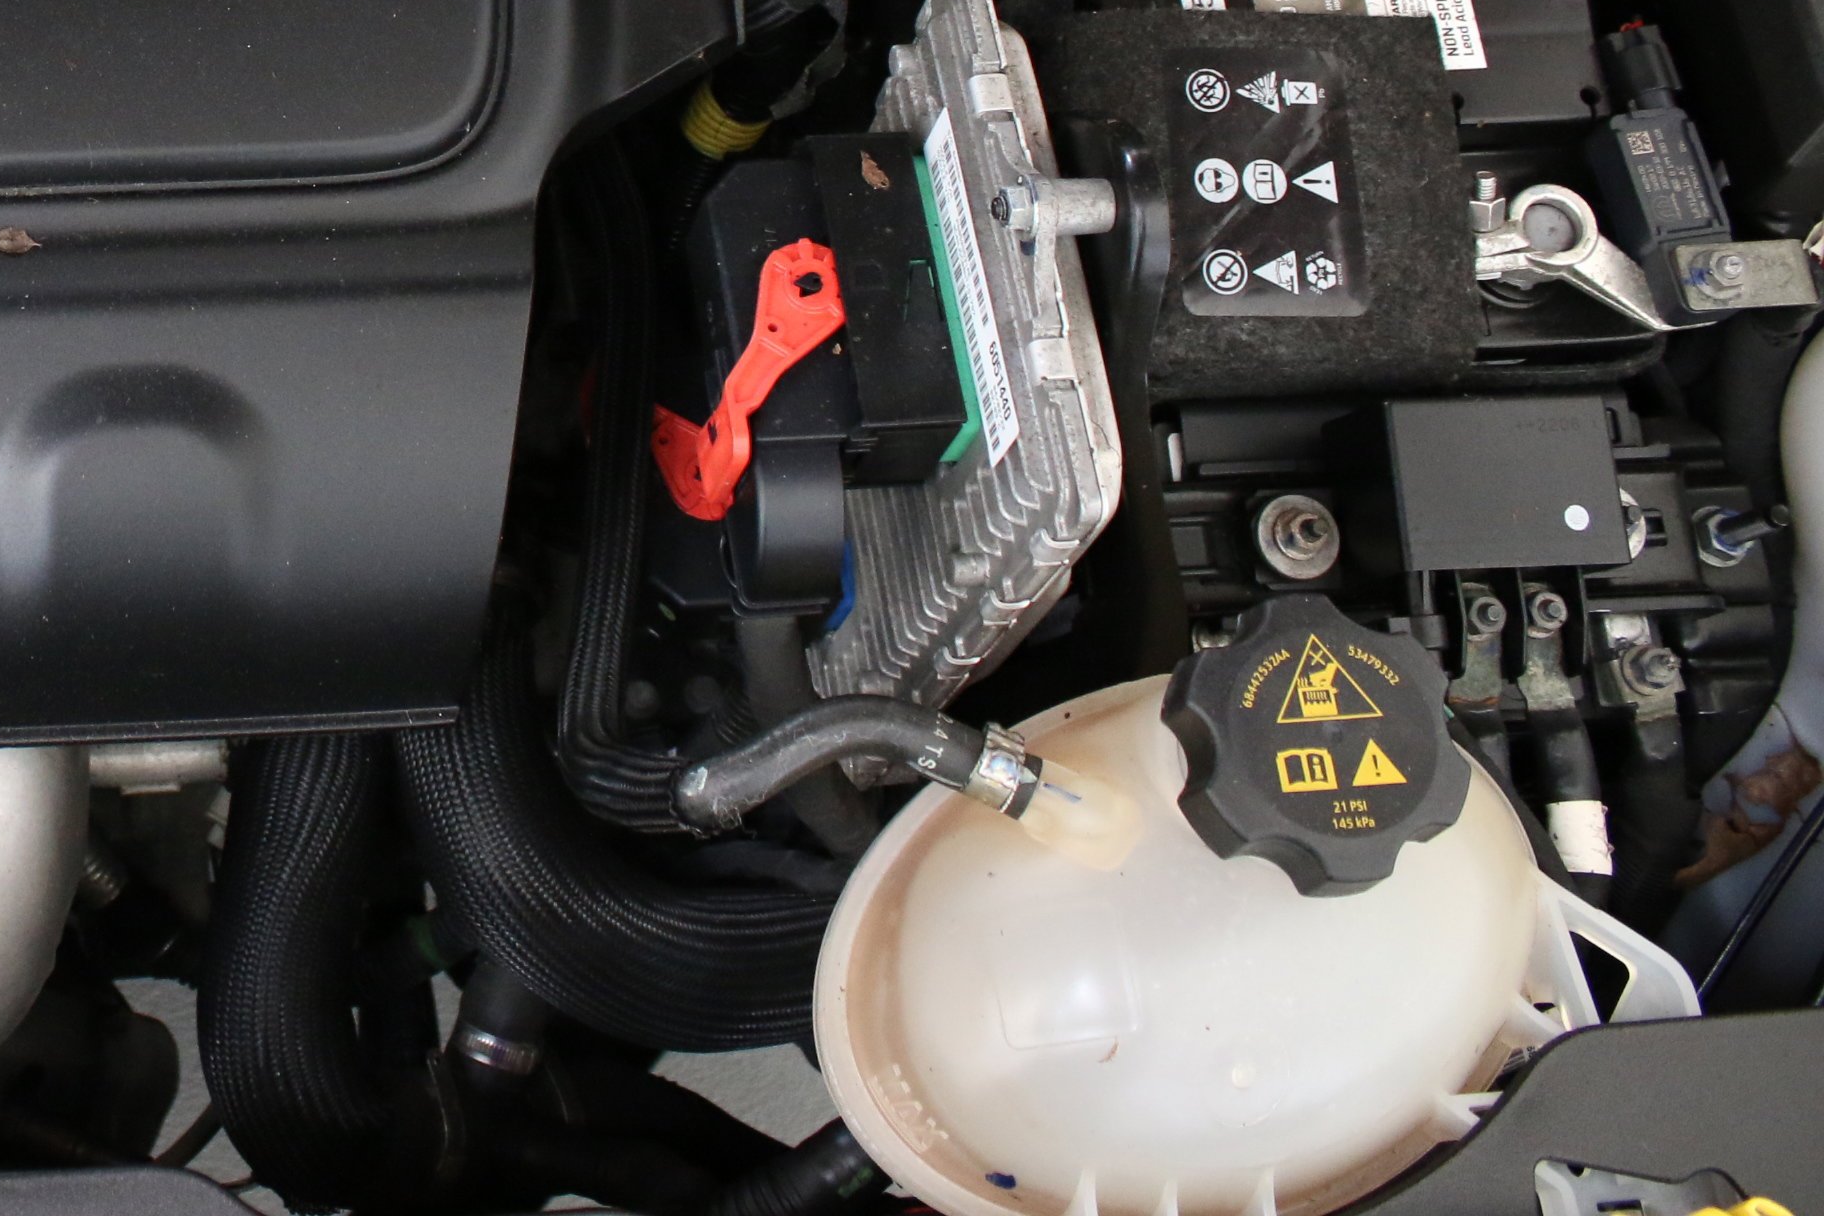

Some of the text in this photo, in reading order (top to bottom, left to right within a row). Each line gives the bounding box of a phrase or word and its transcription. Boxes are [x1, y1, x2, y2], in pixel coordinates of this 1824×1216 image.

[1457, 26, 1475, 57] Lead
[988, 339, 1013, 421] 6051440
[1242, 648, 1291, 709] 68442532AA
[1347, 645, 1400, 686] 53479332
[1332, 816, 1376, 830] 145 kPa
[1333, 799, 1368, 813] 21 PSI
